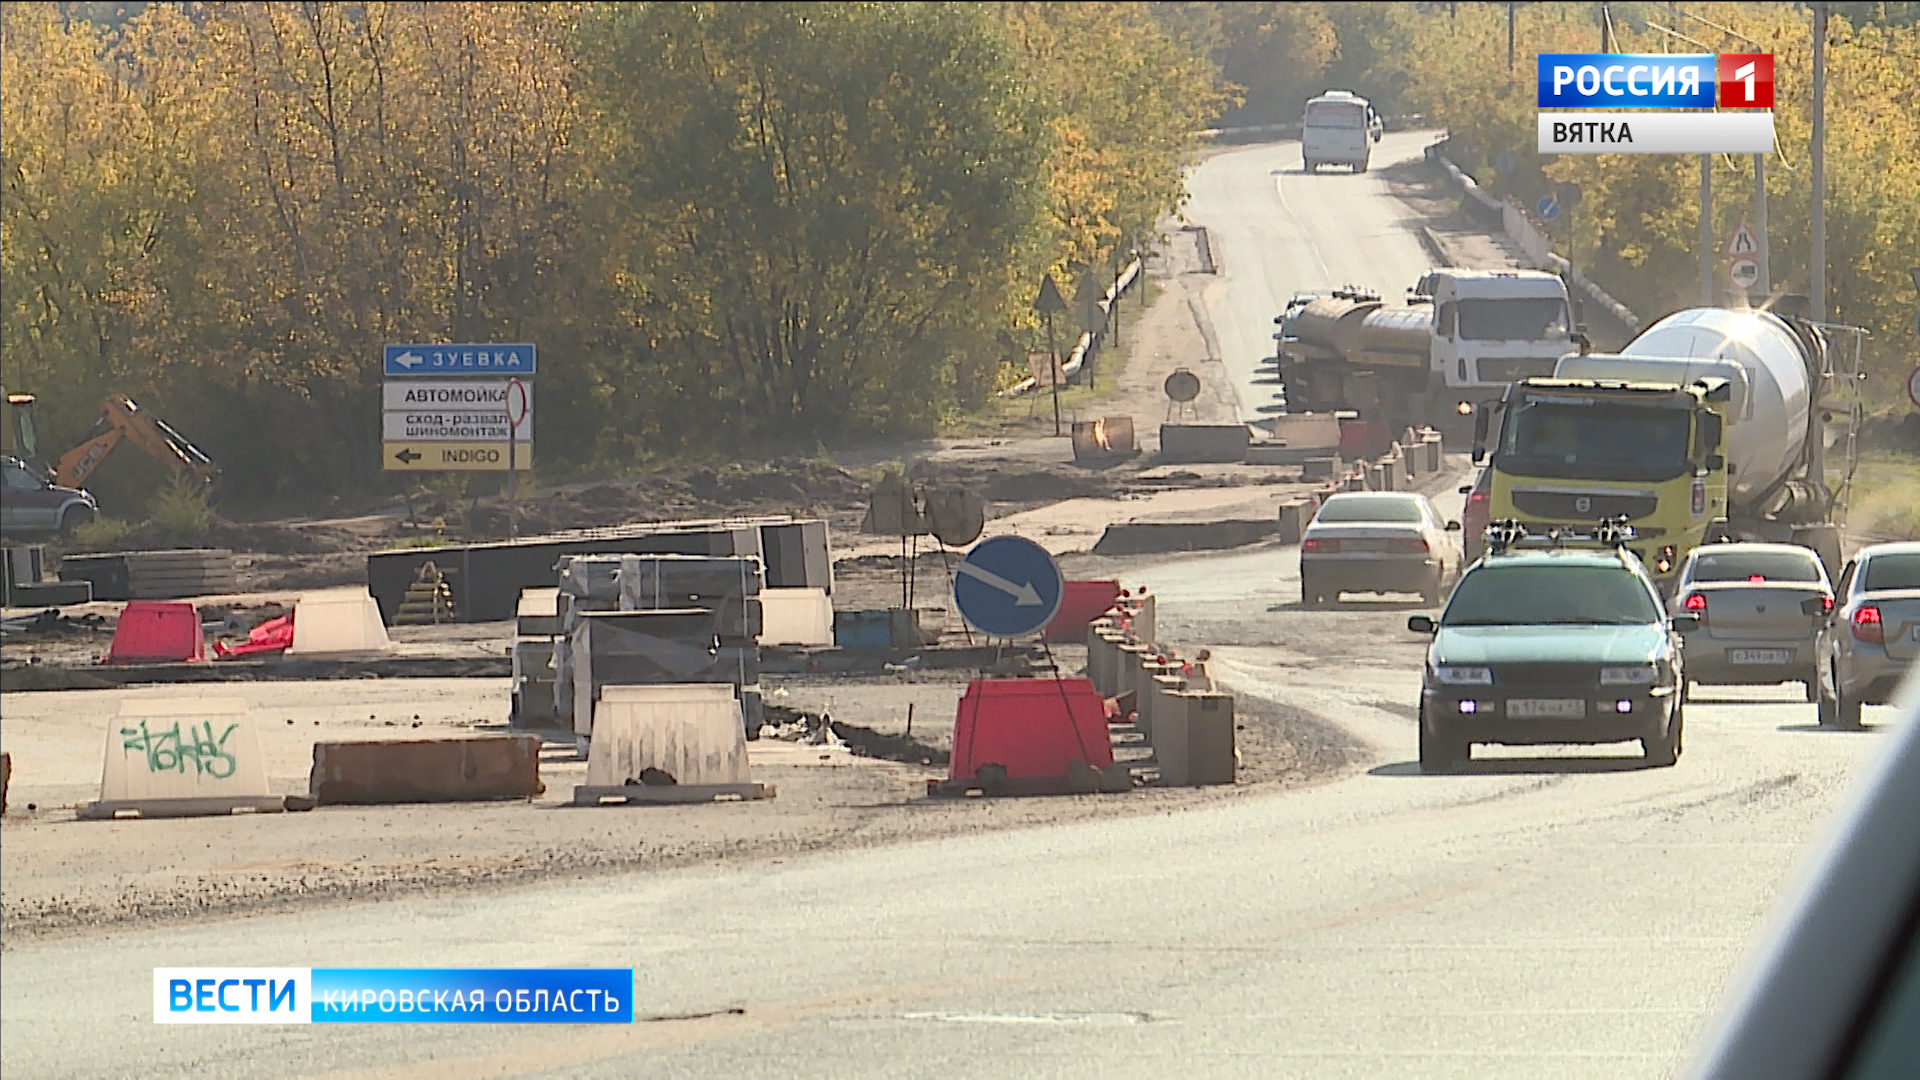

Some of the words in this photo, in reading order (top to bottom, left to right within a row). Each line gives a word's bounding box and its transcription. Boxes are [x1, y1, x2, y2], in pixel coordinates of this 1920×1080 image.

[432, 351, 521, 367] ЗУЕВКА
[405, 386, 508, 402] АВТОМОЙКА
[406, 427, 508, 437] шиномонтаж
[441, 449, 500, 462] INDIGO
